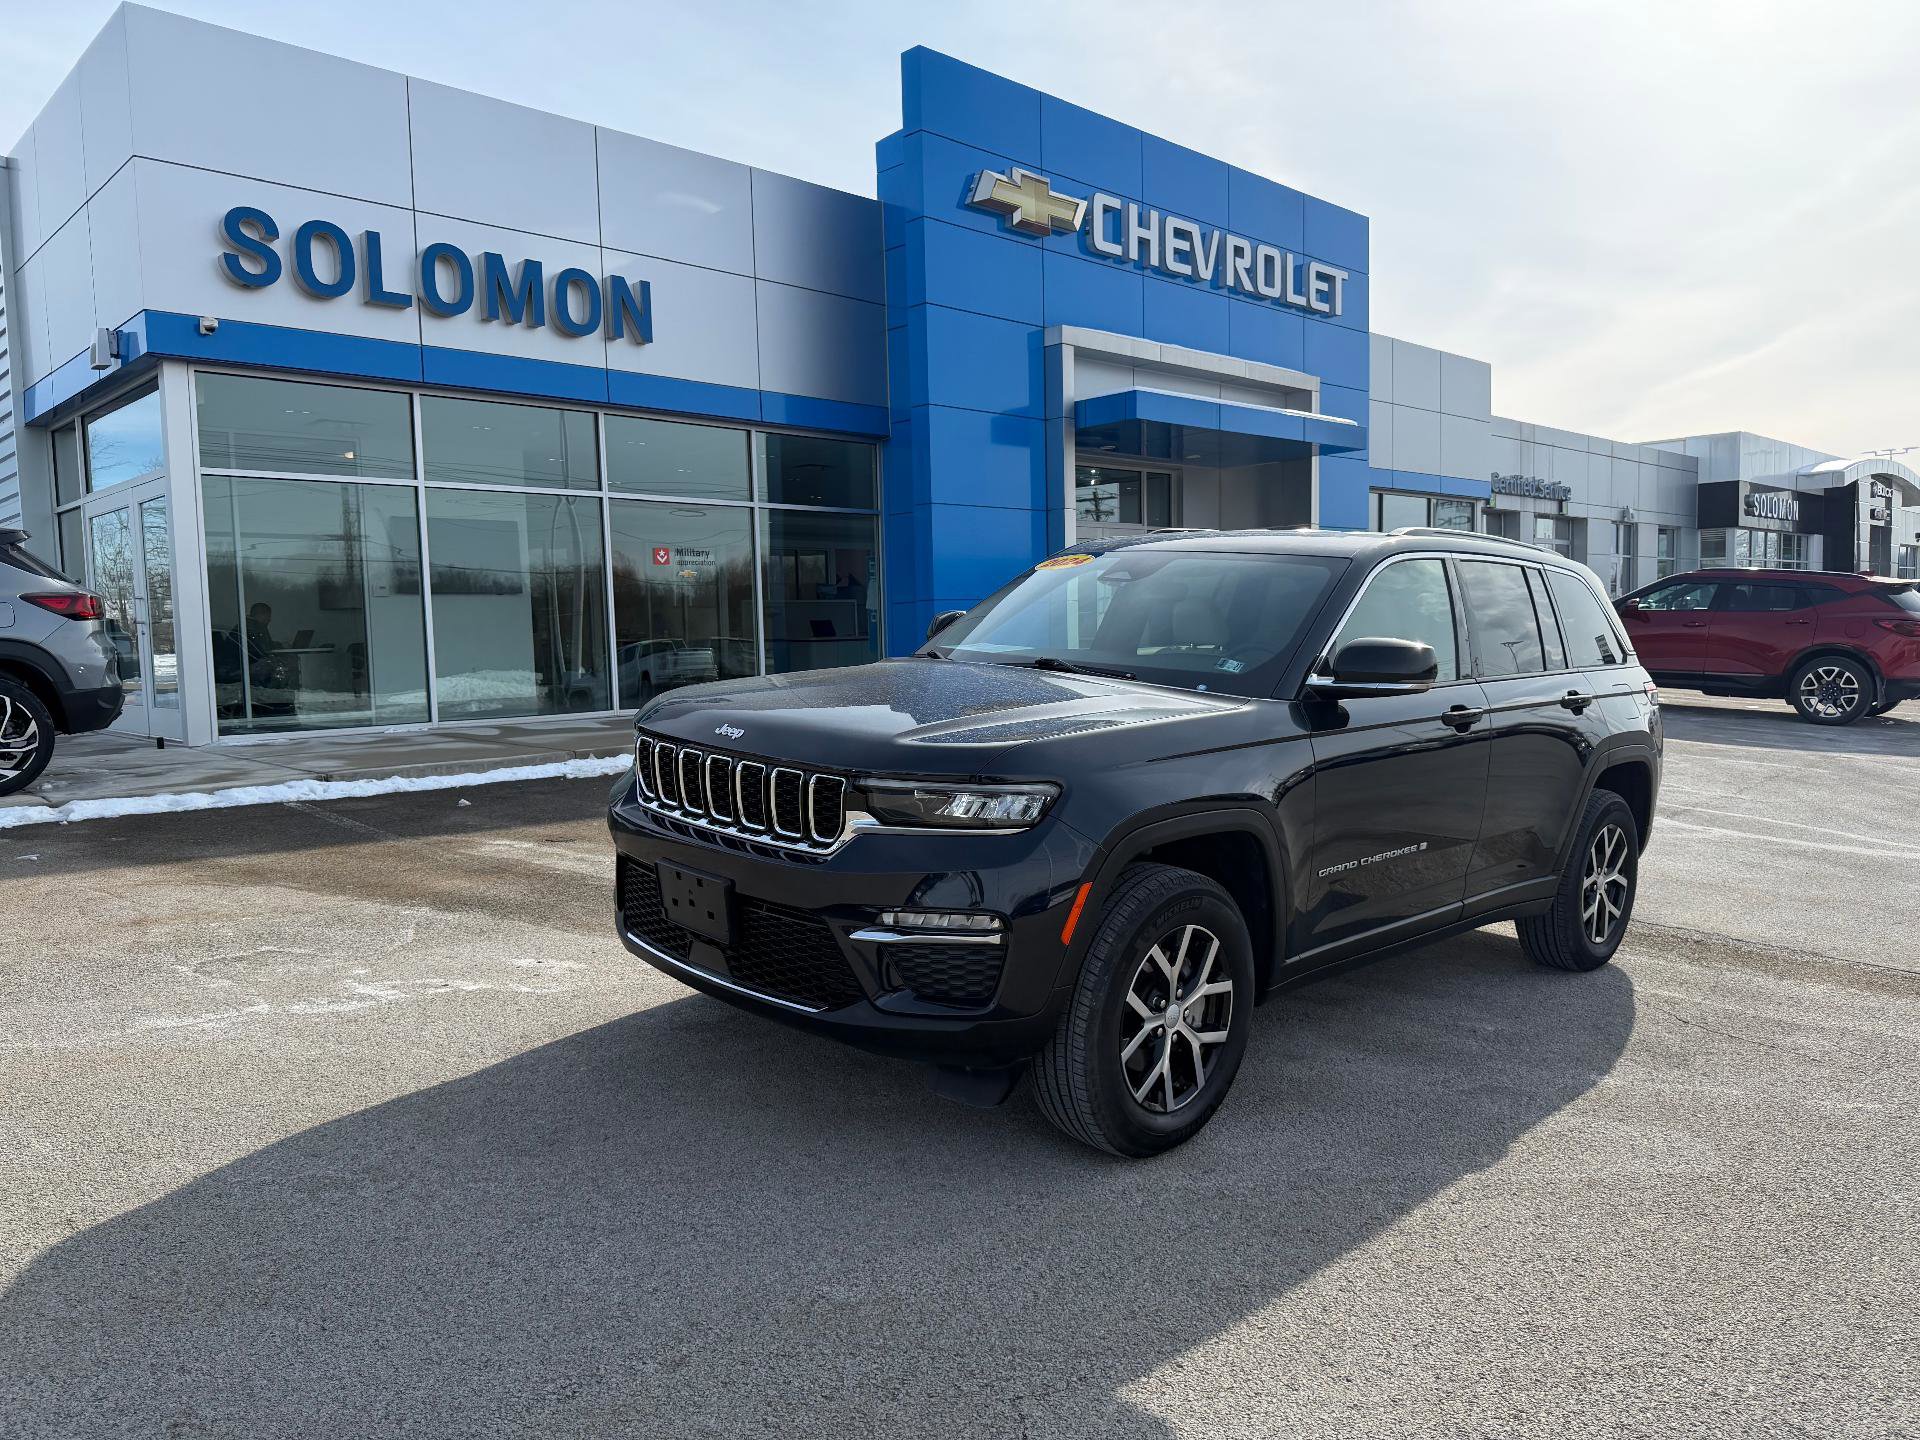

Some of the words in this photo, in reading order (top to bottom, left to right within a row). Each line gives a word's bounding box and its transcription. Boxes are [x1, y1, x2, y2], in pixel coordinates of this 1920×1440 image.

[1086, 192, 1349, 317] CHEVROLET
[218, 206, 654, 345] SOLOMON
[1491, 472, 1536, 497] Certified
[1538, 478, 1571, 501] Service
[1753, 493, 1799, 521] SOLOMON
[675, 548, 710, 558] Military
[715, 723, 745, 740] Jeep
[1318, 860, 1358, 877] GRAND
[1360, 844, 1418, 866] CHEROKEE
